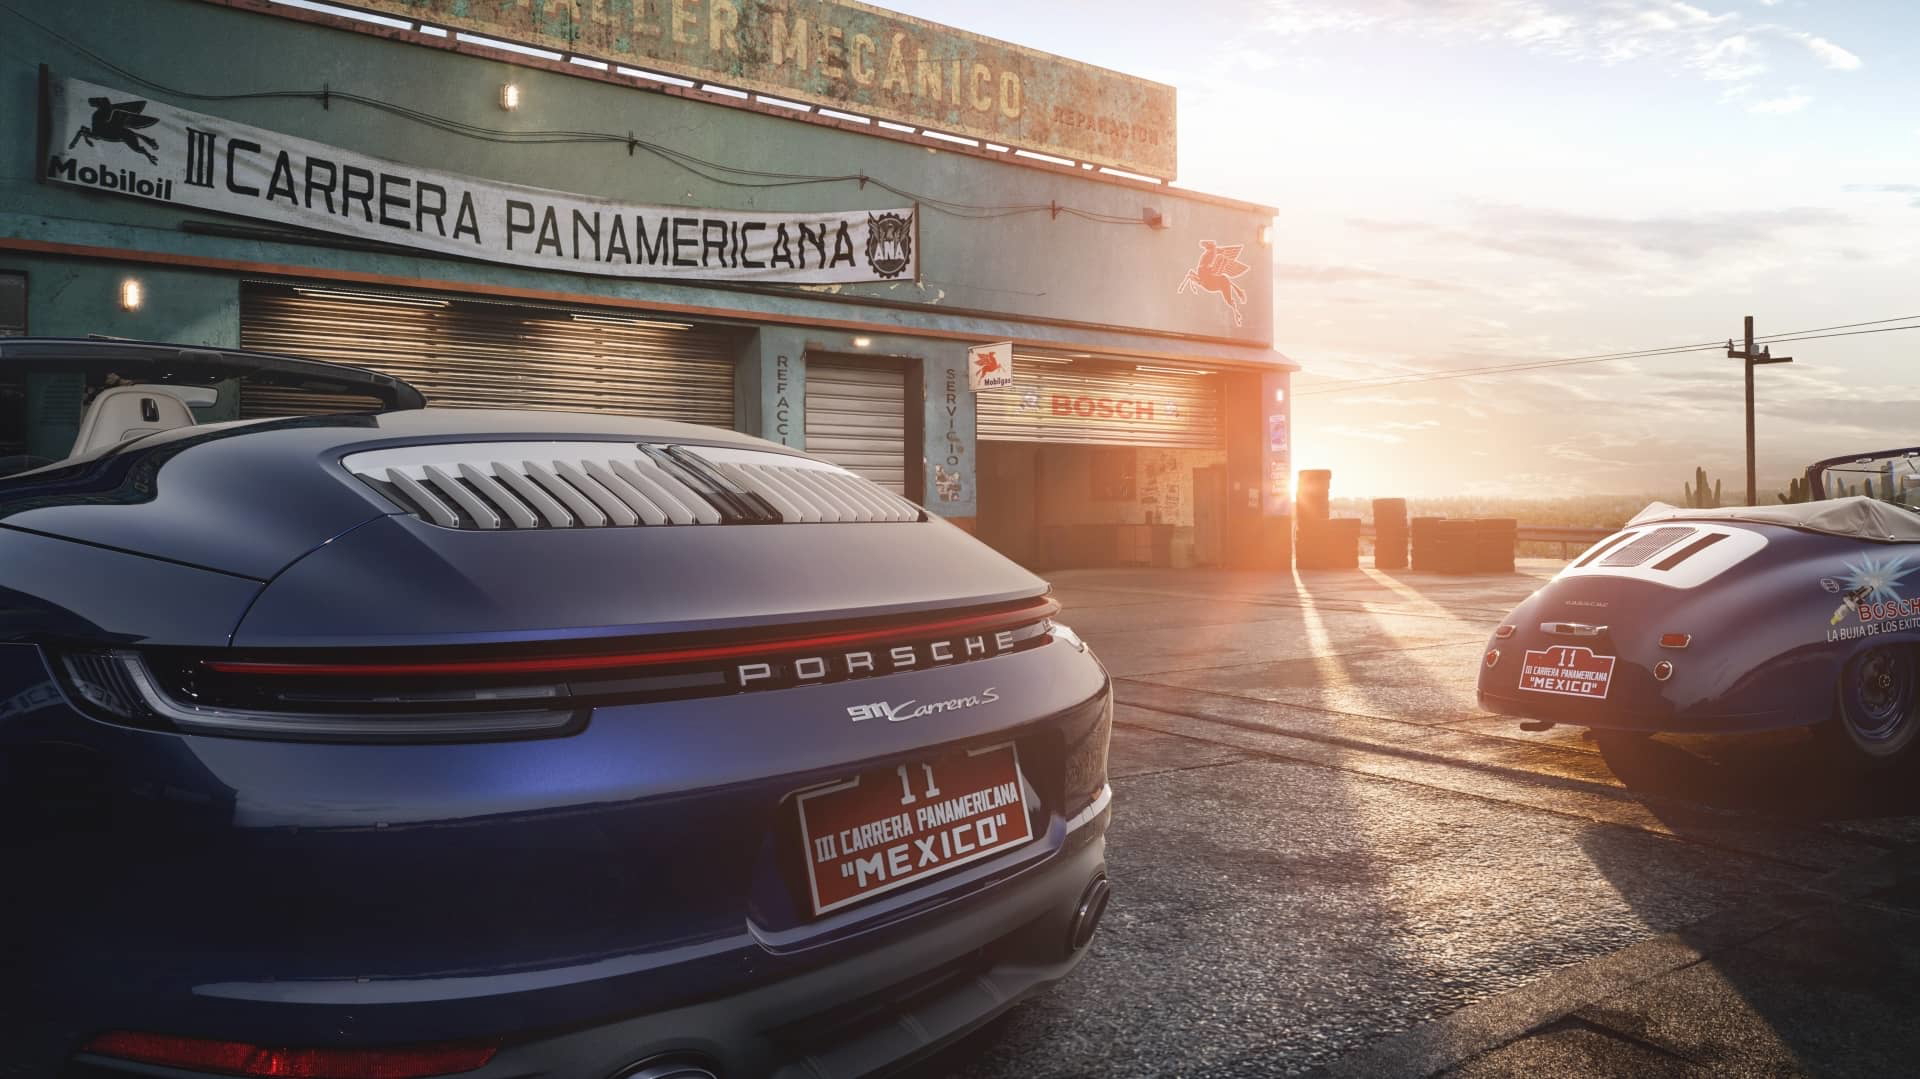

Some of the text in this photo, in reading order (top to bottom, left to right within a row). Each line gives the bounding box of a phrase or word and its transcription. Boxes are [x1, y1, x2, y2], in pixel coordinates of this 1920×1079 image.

[517, 0, 1022, 119] LLER MECÁNICO
[47, 154, 173, 201] Mobiloil
[185, 126, 857, 269] III CARRERA PANAMERICANA
[873, 240, 906, 261] ANA
[984, 376, 1012, 387] Mobilgas
[945, 368, 959, 465] SERVICIO
[1050, 393, 1155, 420] BOSCH
[1858, 597, 1920, 622] BOSCH
[1827, 628, 1839, 642] LA
[1840, 626, 1866, 640] BUJIA
[1868, 623, 1880, 636] DE
[1881, 620, 1898, 633] LOS
[738, 631, 1015, 686] PORSCHE
[1533, 666, 1559, 678] CARRERA
[1561, 668, 1608, 681] PANAMERICANA
[1558, 649, 1576, 667] 11
[1530, 676, 1597, 693] "MEXICO"
[847, 687, 1000, 722] 911 Carrera S
[898, 763, 940, 805] 11
[815, 782, 1018, 863] III CARRERA PANAMERICANA
[841, 812, 1007, 888] "MEXICO"
